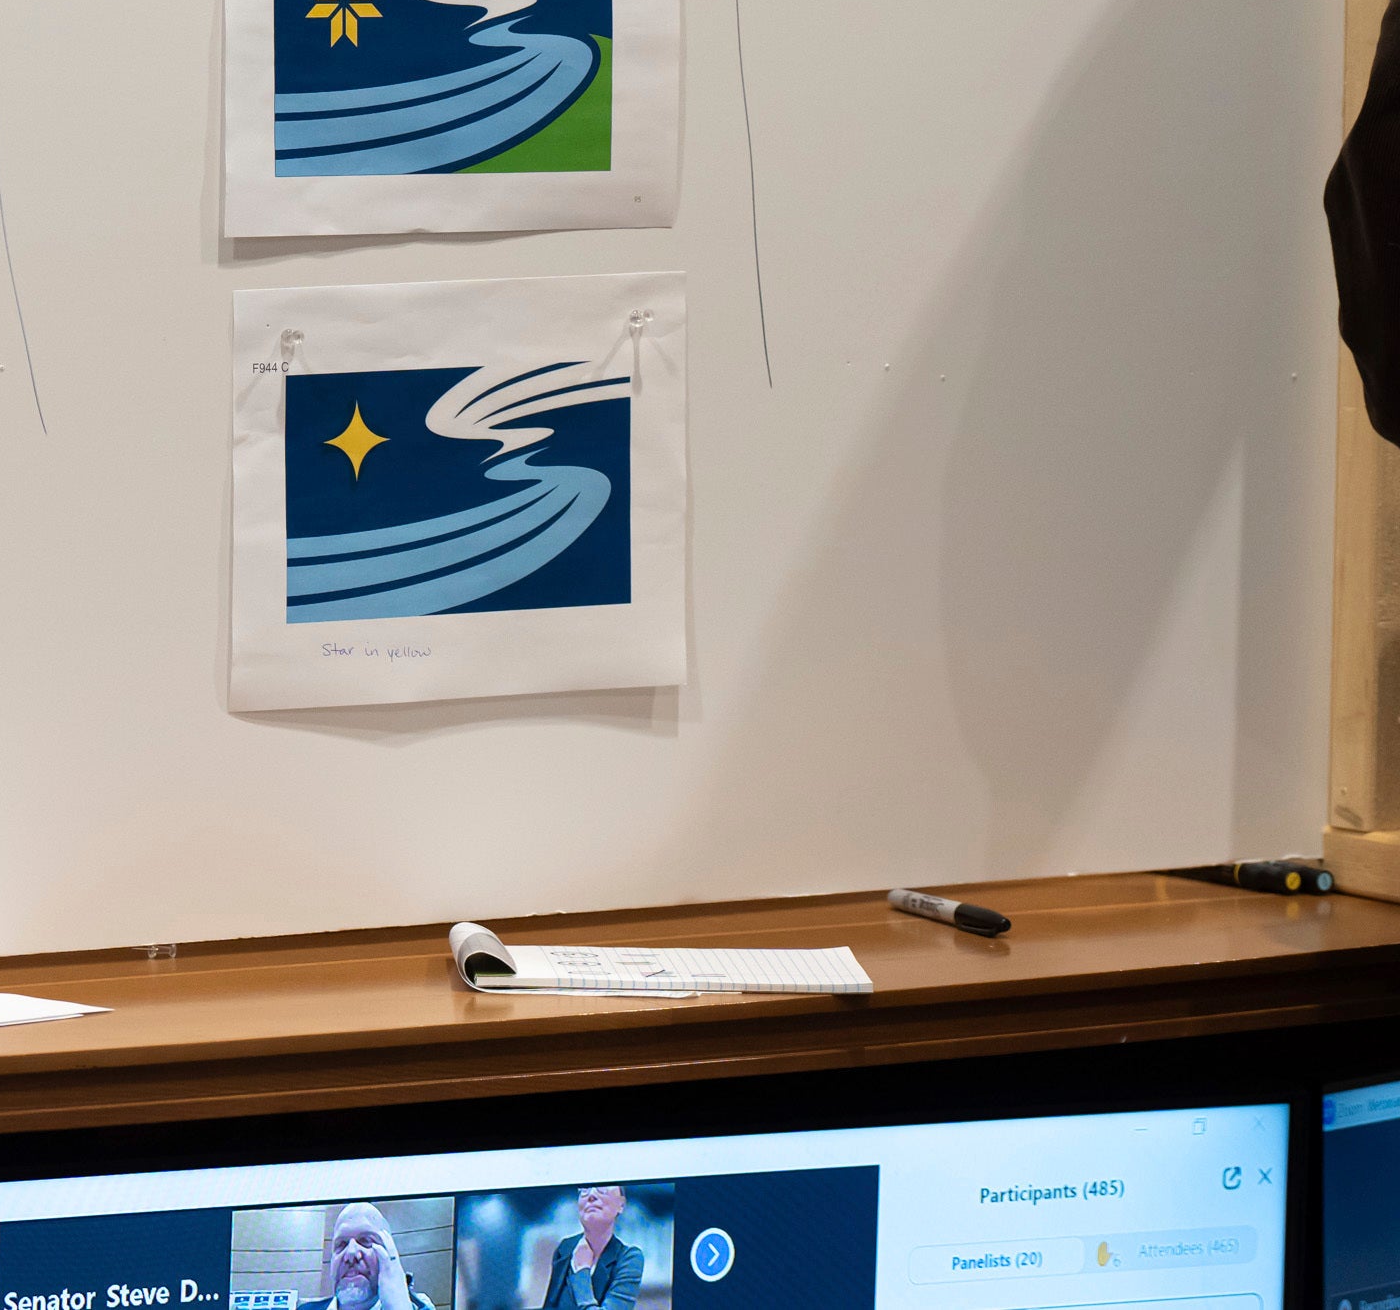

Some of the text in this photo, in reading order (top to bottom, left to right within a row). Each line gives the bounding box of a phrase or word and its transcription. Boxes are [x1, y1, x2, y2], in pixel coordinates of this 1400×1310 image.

[252, 361, 289, 374] F944 C
[322, 642, 432, 663] Star in yellow
[980, 1179, 1125, 1205] Participants (485)
[1139, 1242, 1202, 1258] Attendees
[952, 1251, 1043, 1271] Panelists (20)
[3, 1278, 219, 1310] Senator Steve D...
